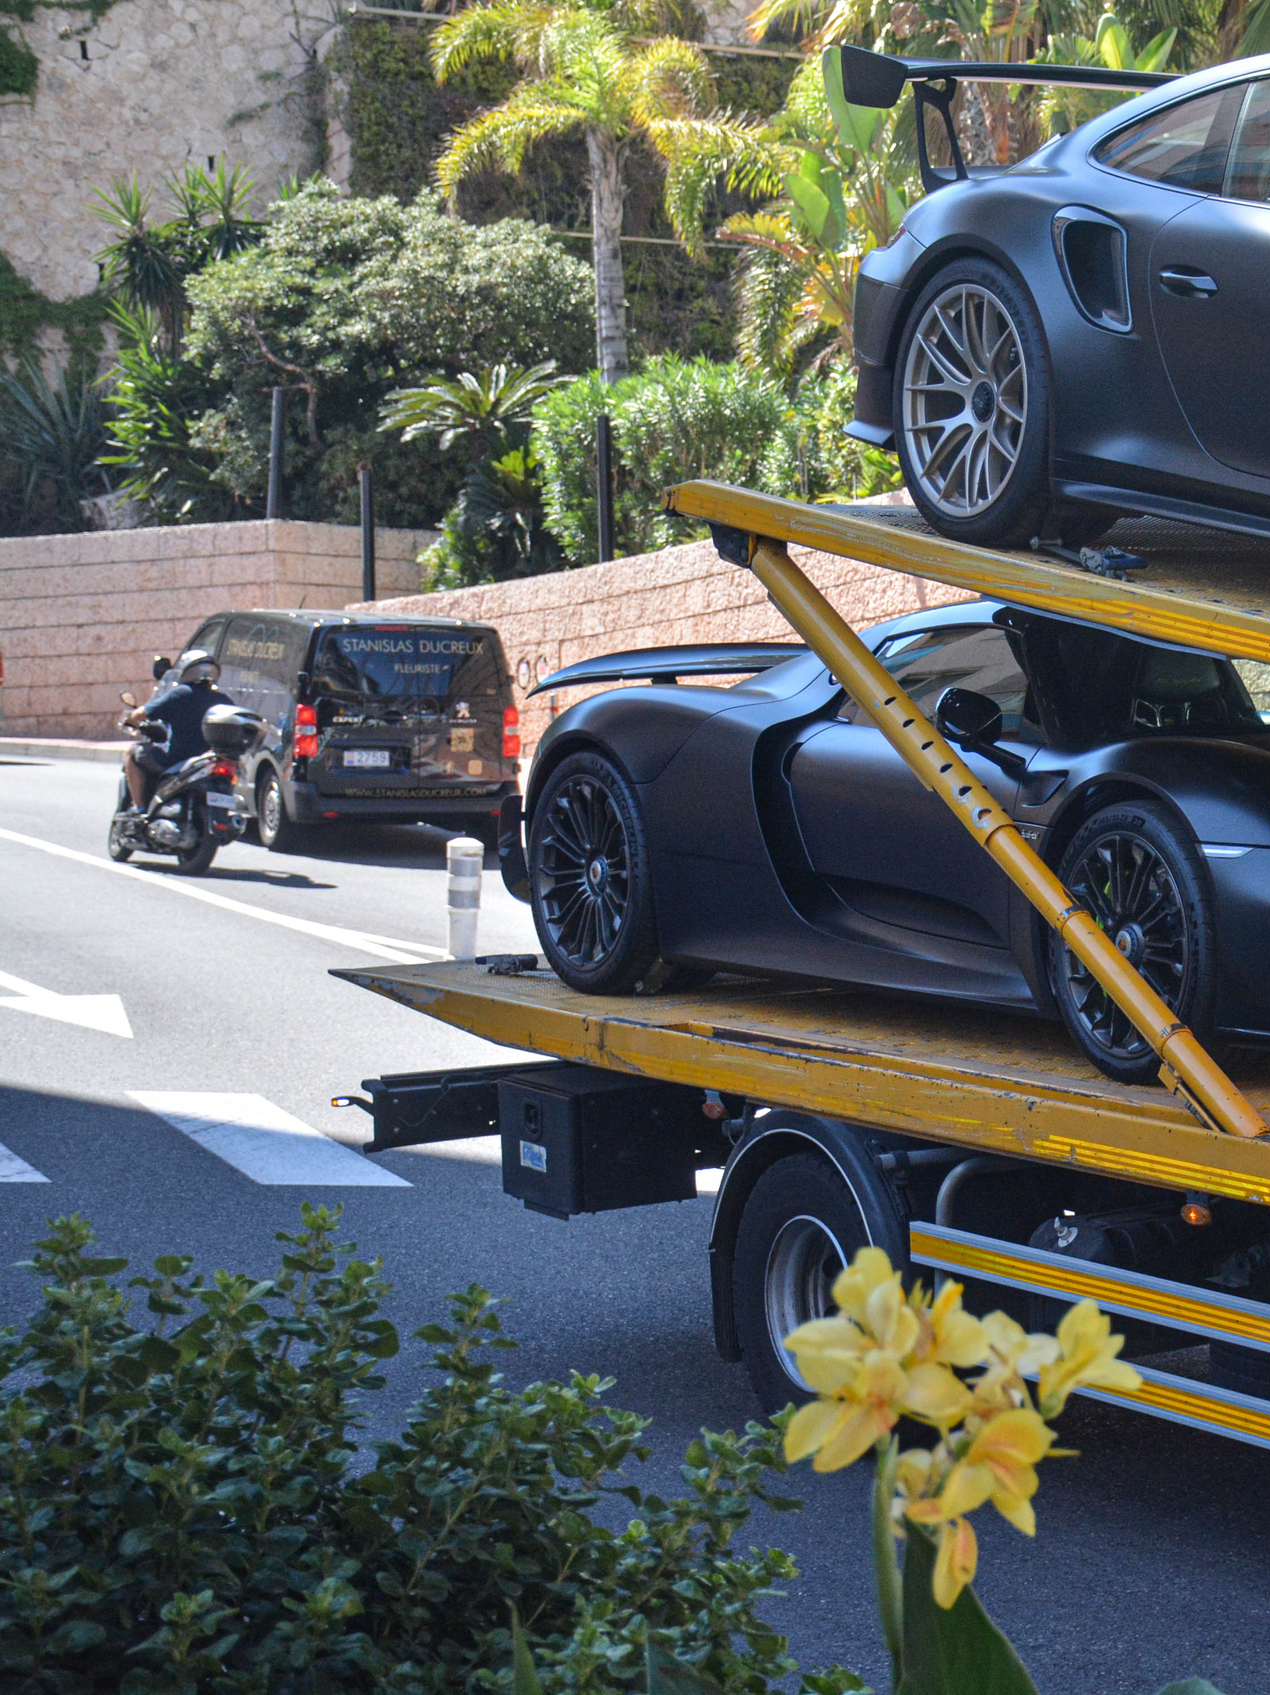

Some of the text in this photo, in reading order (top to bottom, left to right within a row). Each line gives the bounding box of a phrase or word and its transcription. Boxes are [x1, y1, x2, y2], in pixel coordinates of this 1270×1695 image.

[343, 638, 484, 655] STANISLAS DUCREUX
[394, 663, 441, 674] FLEURISTE
[332, 715, 364, 723] EXPERT
[357, 752, 387, 764] 2759
